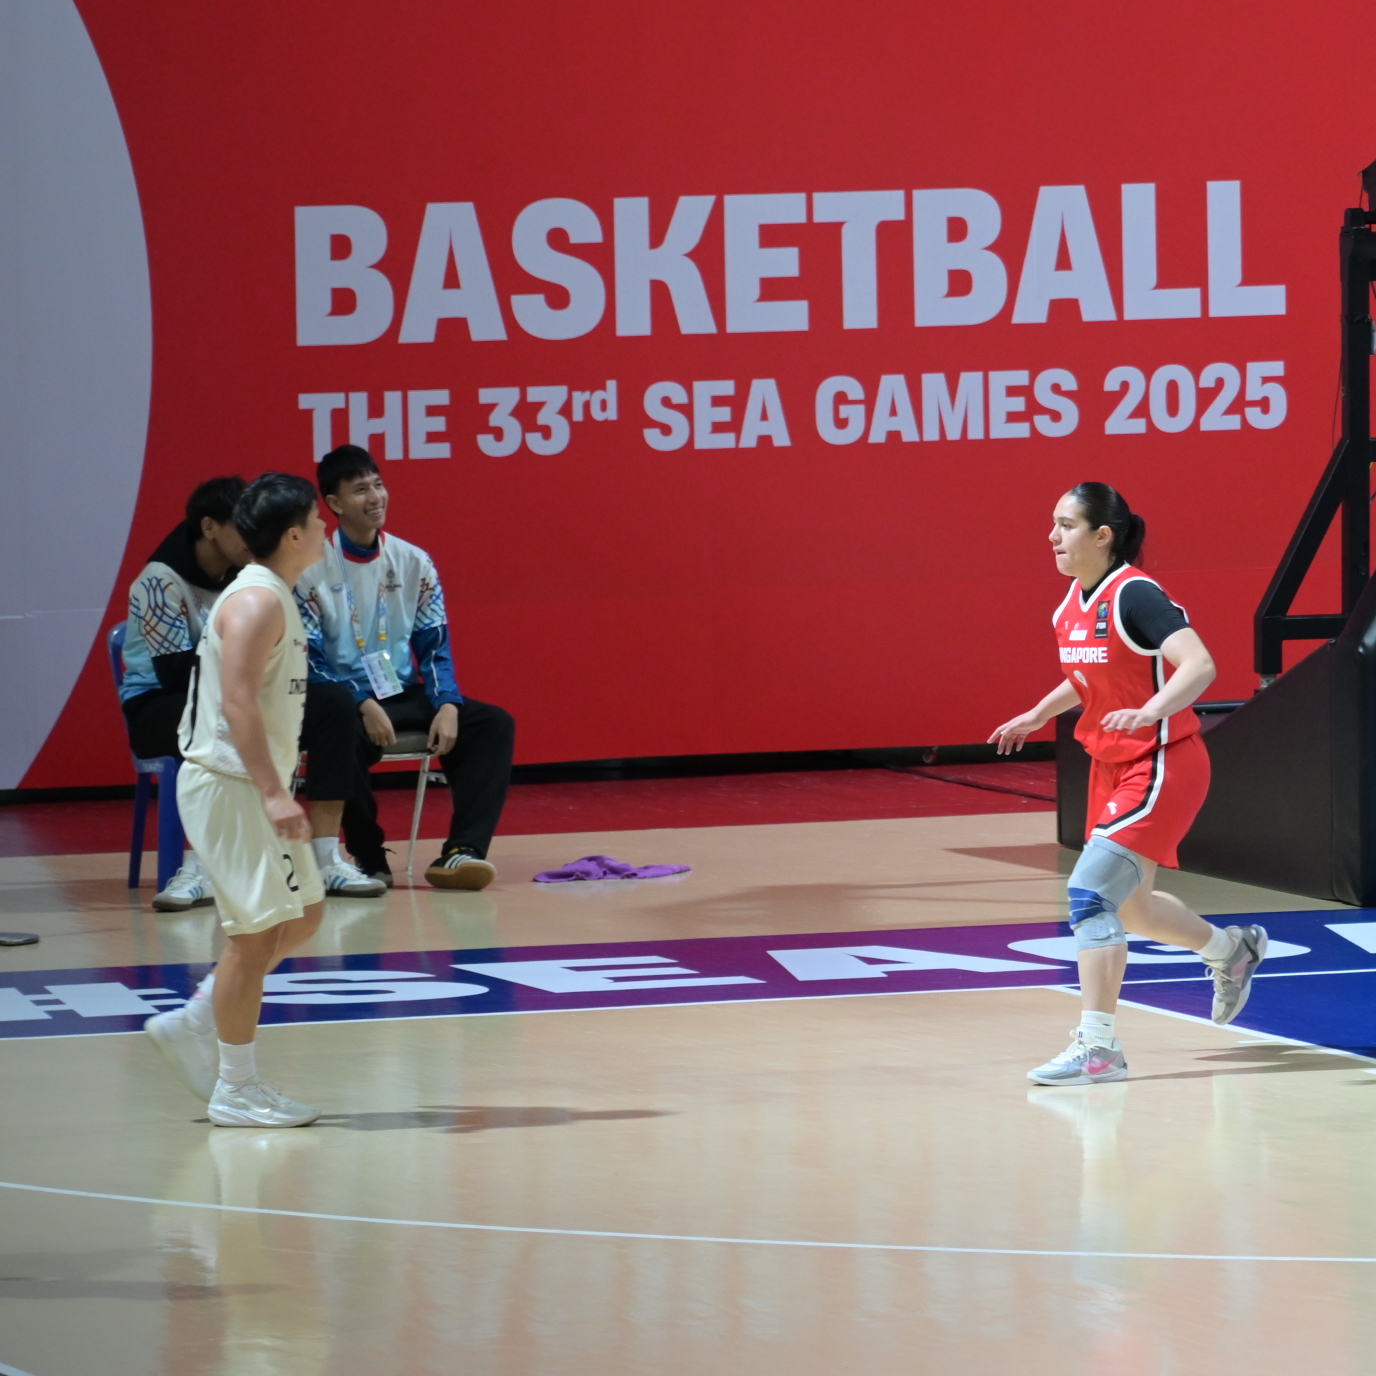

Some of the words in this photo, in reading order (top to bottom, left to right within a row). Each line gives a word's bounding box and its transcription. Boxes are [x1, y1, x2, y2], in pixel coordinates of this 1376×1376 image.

[293, 180, 1287, 346] BASKETBALL
[298, 389, 451, 462] THE
[476, 379, 618, 458] 33rd
[642, 377, 791, 451] SEA
[814, 367, 1078, 445] GAMES
[1102, 360, 1287, 435] 2025
[282, 853, 300, 893] 2
